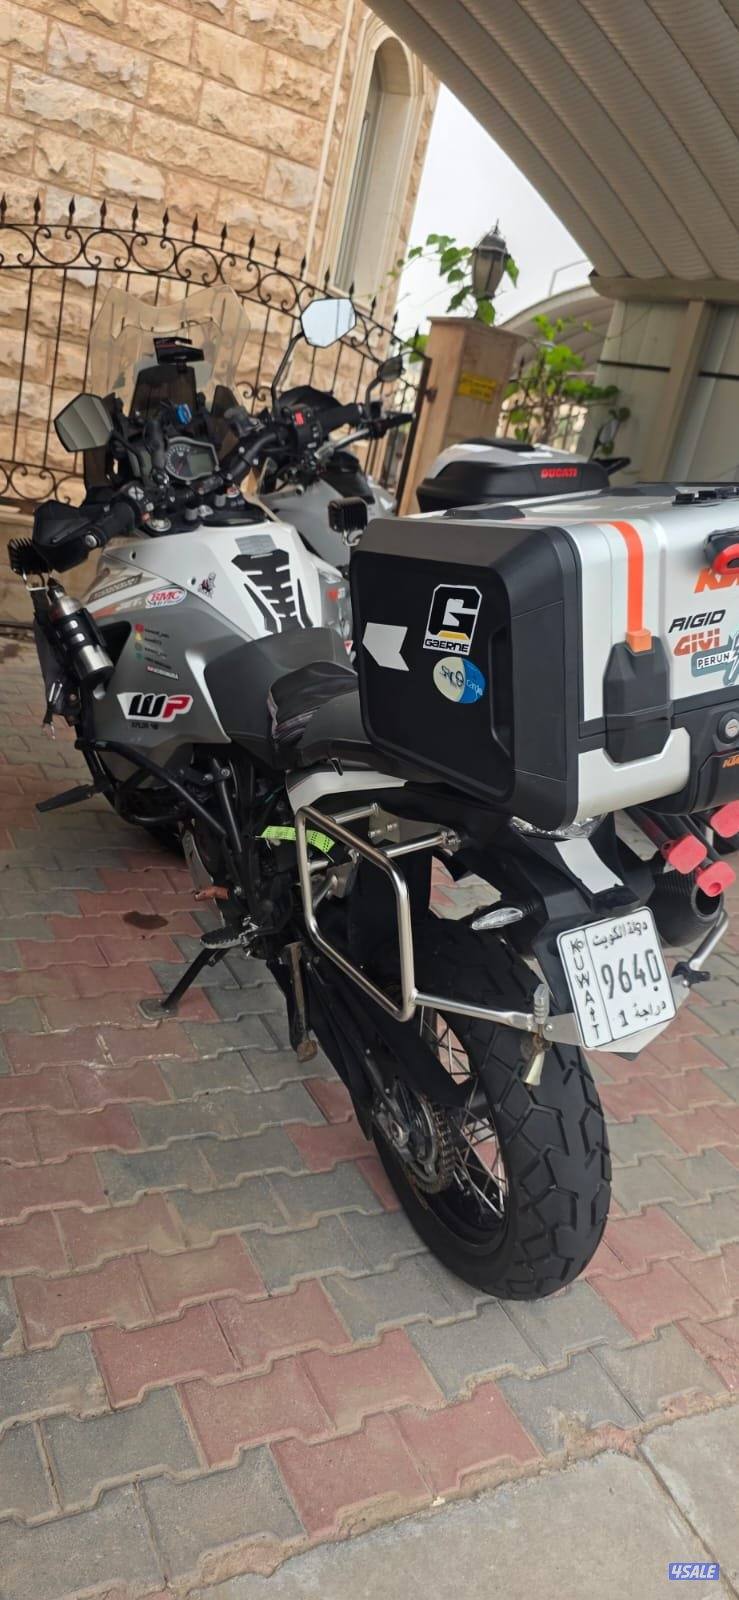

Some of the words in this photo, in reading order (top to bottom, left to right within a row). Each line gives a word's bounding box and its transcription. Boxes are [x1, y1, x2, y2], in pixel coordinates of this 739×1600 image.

[541, 467, 578, 479] DUCATI
[673, 628, 720, 656] GIVI
[697, 652, 730, 669] PERUN
[592, 923, 627, 949] الكويت
[600, 948, 662, 999] 9640
[569, 938, 600, 1040] KUWAIT
[618, 1010, 629, 1028] 1
